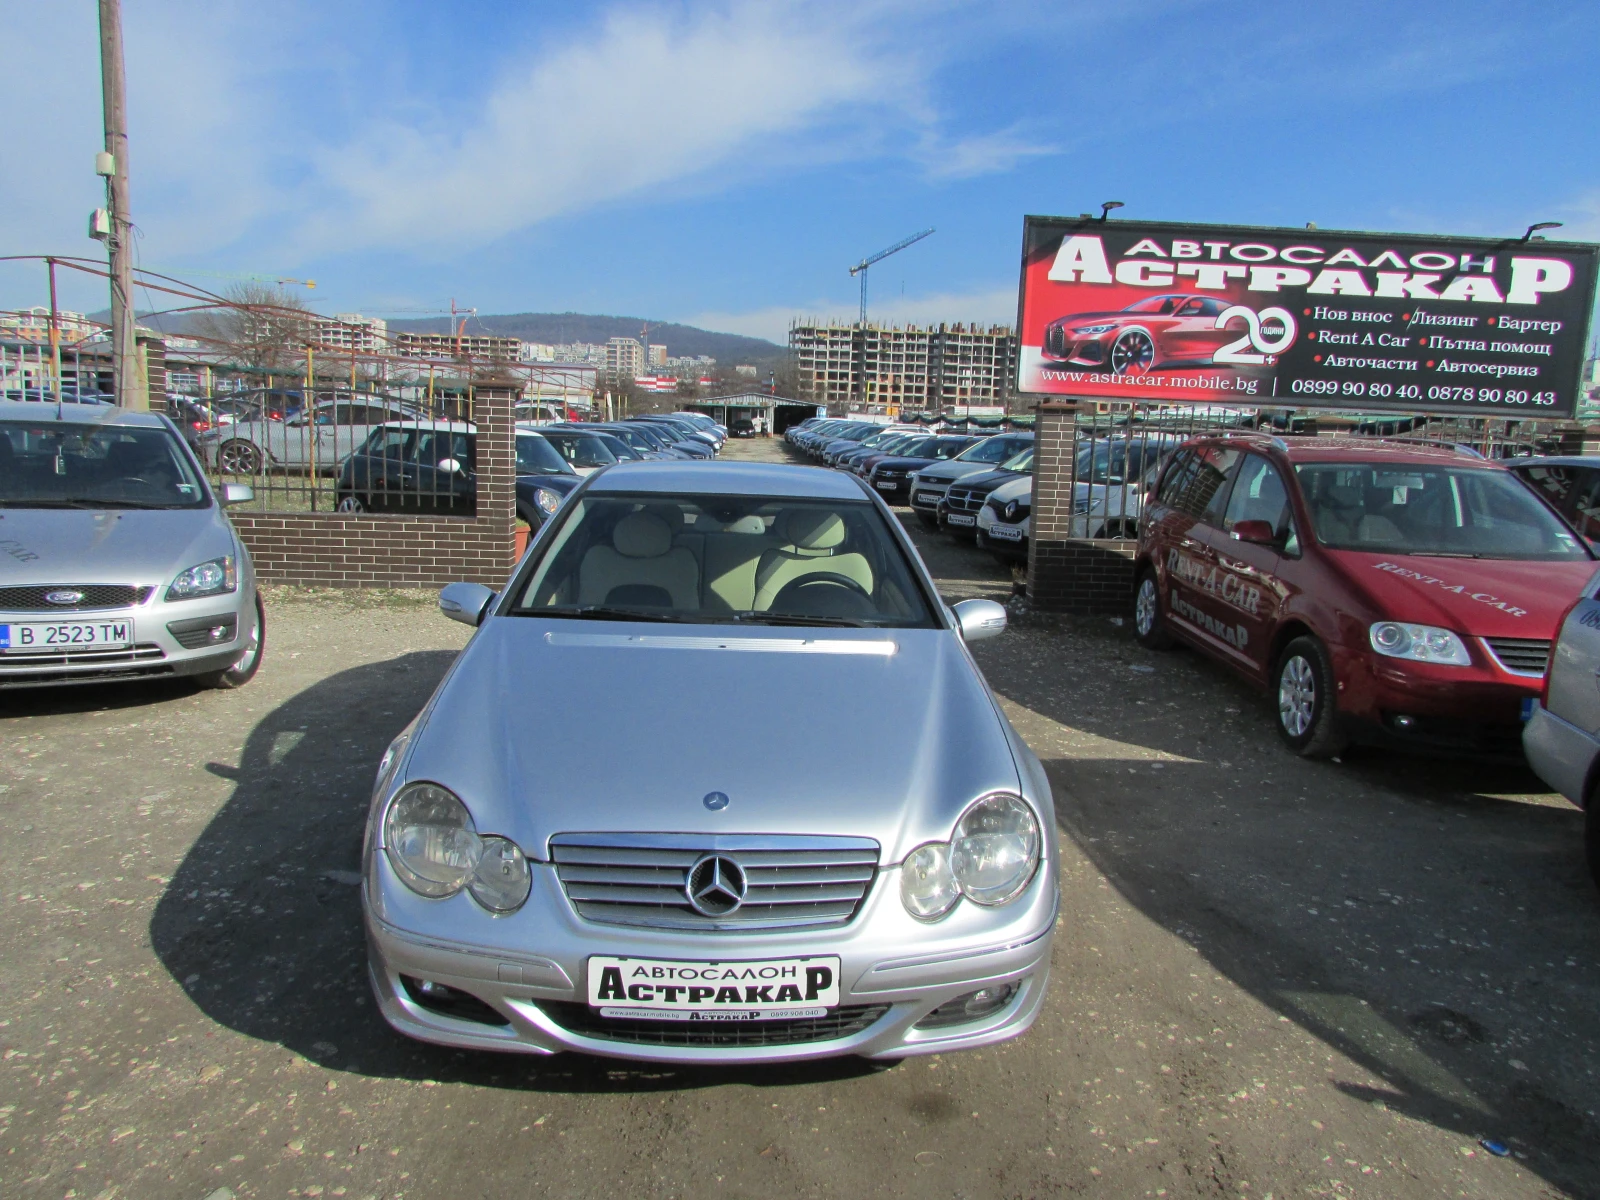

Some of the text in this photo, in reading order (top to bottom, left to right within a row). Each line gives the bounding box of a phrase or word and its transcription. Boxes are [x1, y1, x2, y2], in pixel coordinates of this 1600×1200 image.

[1123, 238, 1496, 273] АВТОСАЛОН
[1313, 306, 1393, 323] Нов внос
[1411, 311, 1478, 327] Лизинг
[1260, 326, 1285, 336] ГОДИНИ
[1497, 315, 1562, 335] Бартер
[1317, 330, 1411, 347] Rent A Car
[1428, 335, 1553, 357] Пътна помощ
[1323, 354, 1418, 371] Авточасти
[1435, 358, 1539, 378] Автосервиз
[1041, 370, 1259, 395] www.astracar.mobile.bg
[1291, 379, 1556, 406] 0899 90 80 40, 0878 90 80 43
[1166, 547, 1260, 614] RENT-A-CAR
[1371, 561, 1527, 618] RENT-A-CAR
[21, 624, 126, 645] B 2523 TM
[631, 965, 797, 981] АВТОСАЛОН
